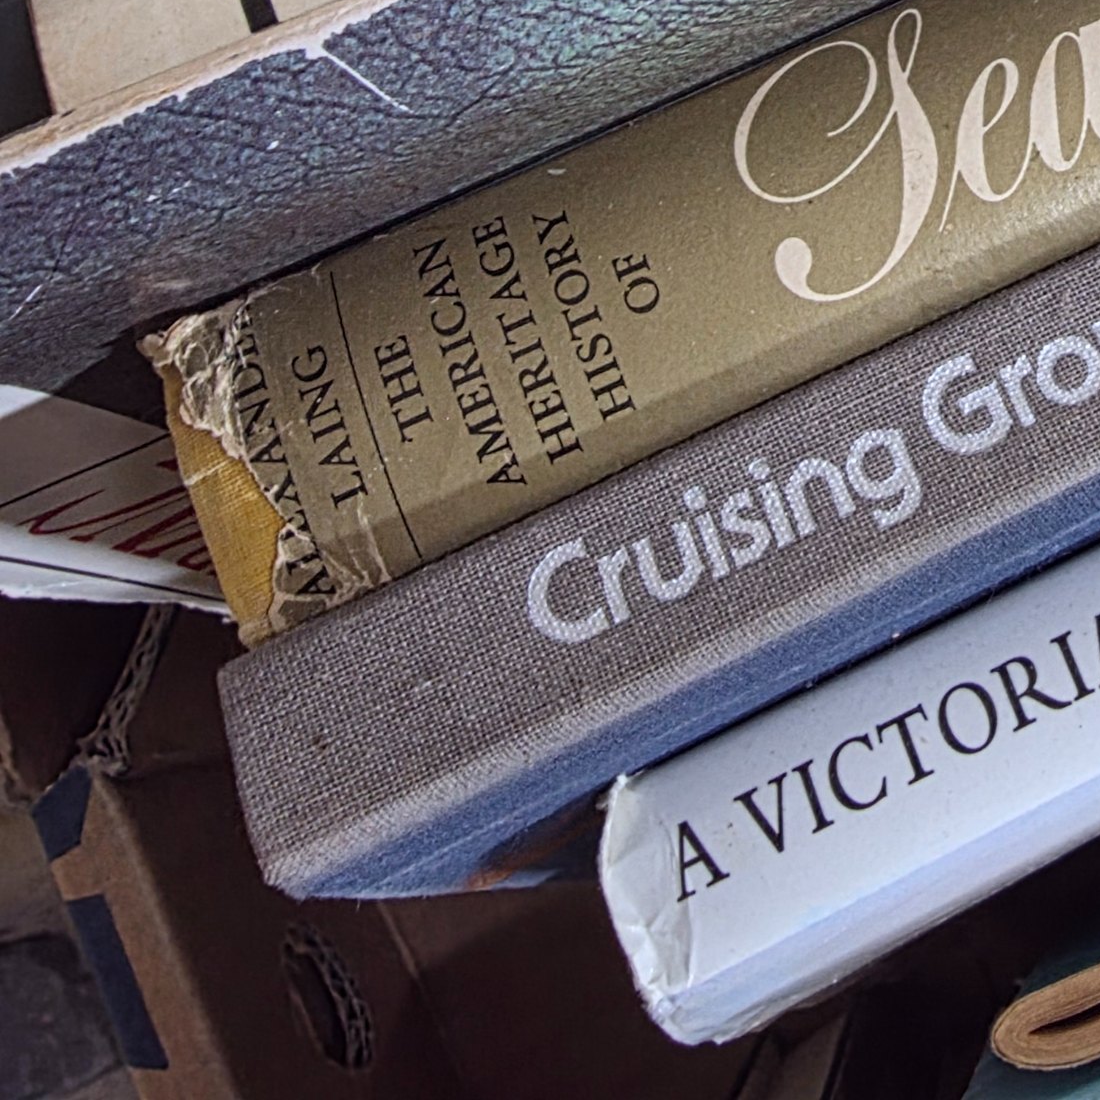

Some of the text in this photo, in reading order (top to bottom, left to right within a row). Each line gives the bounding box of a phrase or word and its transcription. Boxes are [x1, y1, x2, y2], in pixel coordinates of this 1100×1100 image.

[413, 238, 528, 486] AMERICAN
[472, 216, 584, 465] HERITAGE
[532, 210, 637, 421] HISTORY
[611, 253, 660, 314] OF
[291, 345, 369, 509] LAING
[374, 334, 434, 443] THE
[527, 425, 922, 644] Cruising
[674, 820, 731, 903] A
